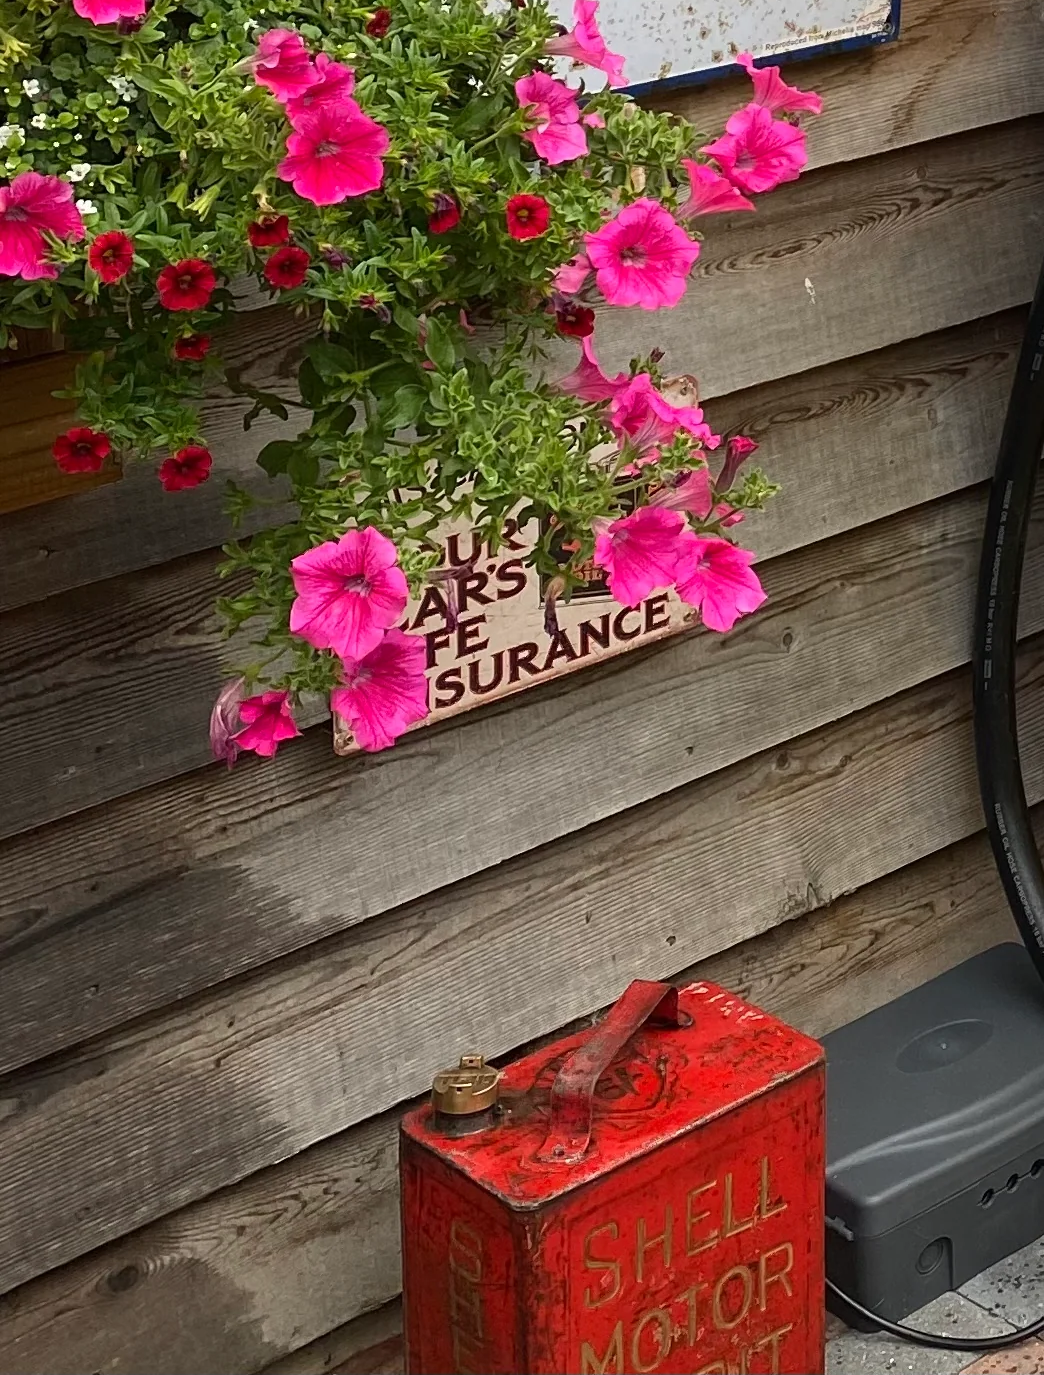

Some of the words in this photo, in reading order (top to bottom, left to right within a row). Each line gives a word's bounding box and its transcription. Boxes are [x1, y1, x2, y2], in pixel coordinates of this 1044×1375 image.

[418, 518, 529, 569] UR
[400, 558, 528, 630] AR'S
[425, 613, 490, 670] FE
[426, 593, 670, 712] SURANCE
[584, 1156, 788, 1308] SHELL
[580, 1242, 794, 1375] MOTOR
